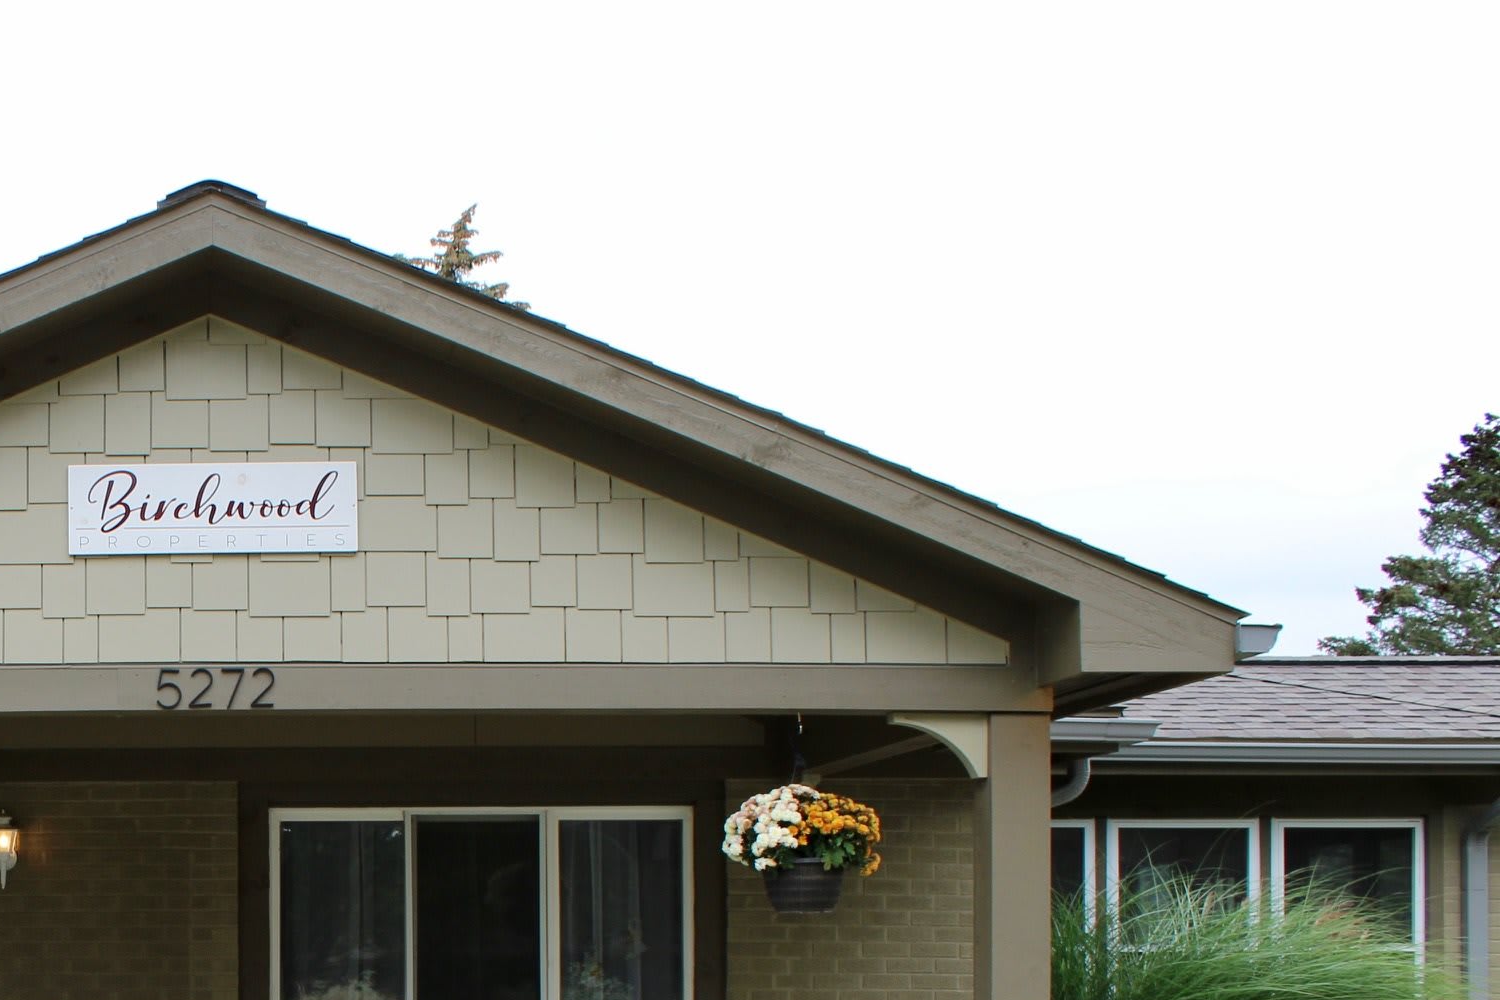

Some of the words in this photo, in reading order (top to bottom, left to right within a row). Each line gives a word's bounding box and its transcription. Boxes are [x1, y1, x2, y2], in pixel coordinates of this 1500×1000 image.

[88, 470, 338, 533] Birchwood
[79, 533, 346, 549] PROPERTIES
[156, 667, 275, 709] 5272
